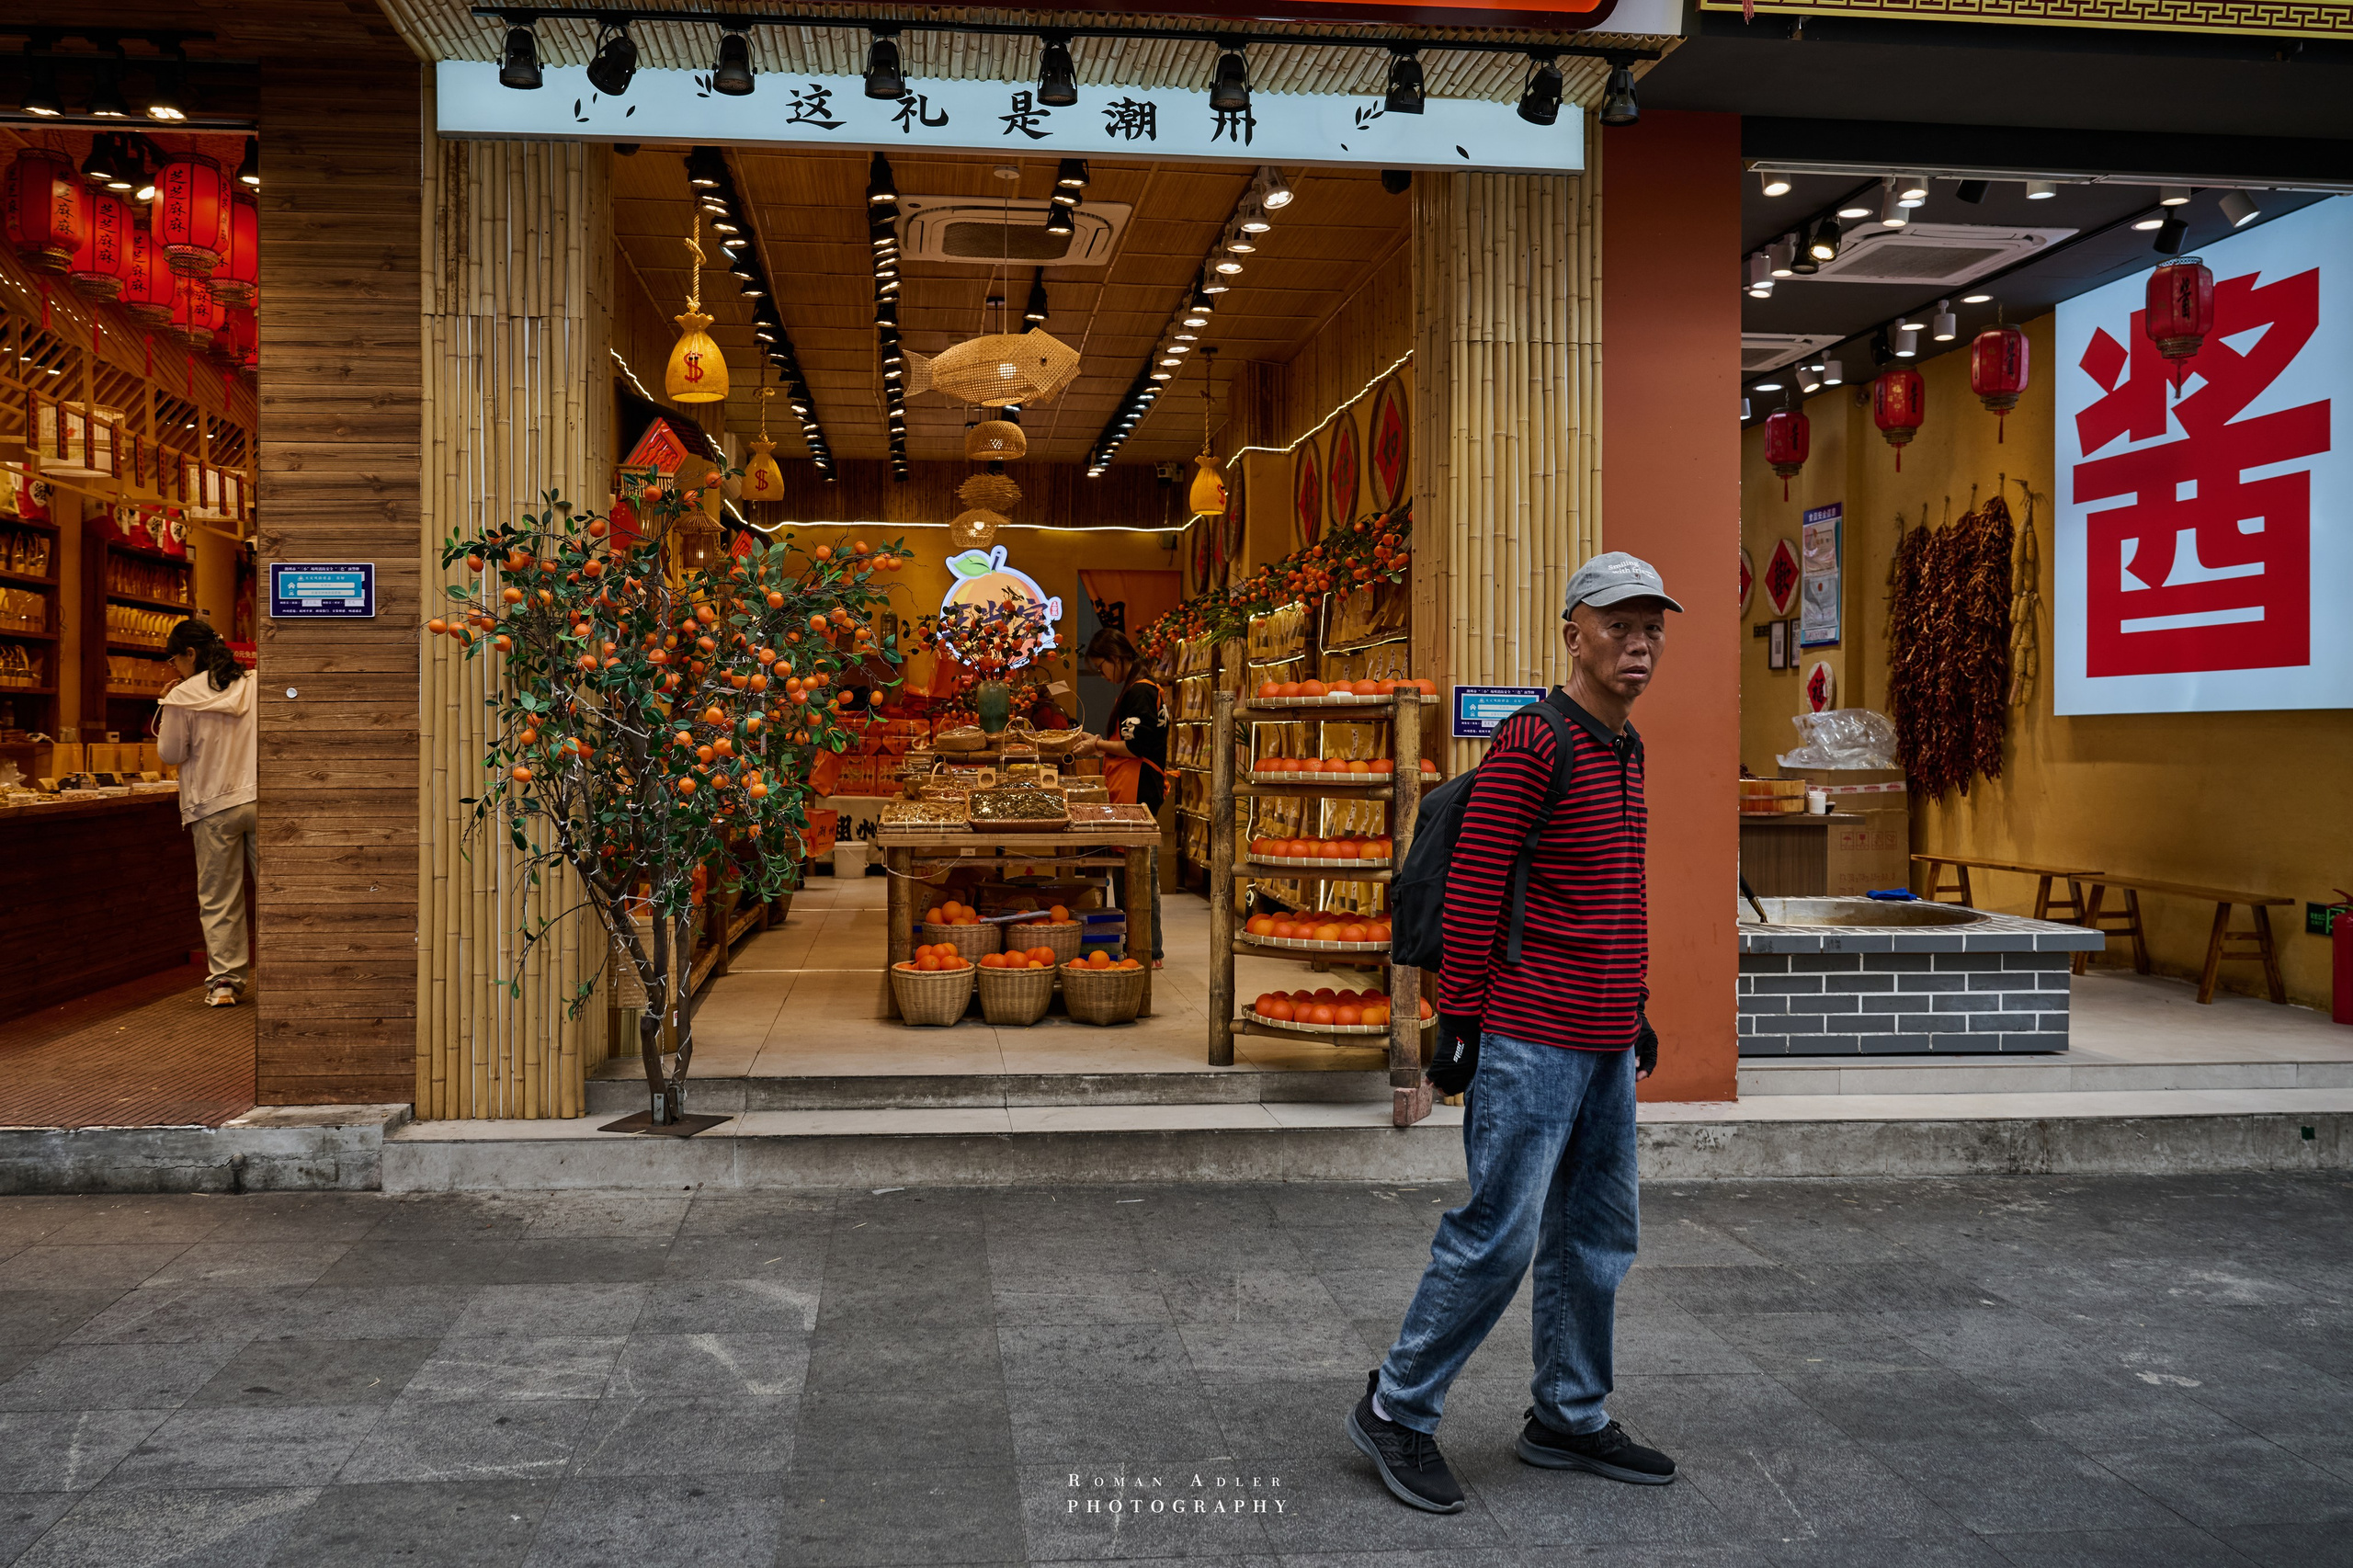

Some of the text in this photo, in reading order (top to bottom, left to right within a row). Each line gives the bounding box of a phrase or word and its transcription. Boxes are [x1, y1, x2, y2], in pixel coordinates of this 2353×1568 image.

[167, 169, 188, 233] 芝芝麻麻
[97, 203, 118, 264] 芝芝麻麻
[2073, 267, 2332, 678] 酱
[1608, 560, 1640, 571] Smiling
